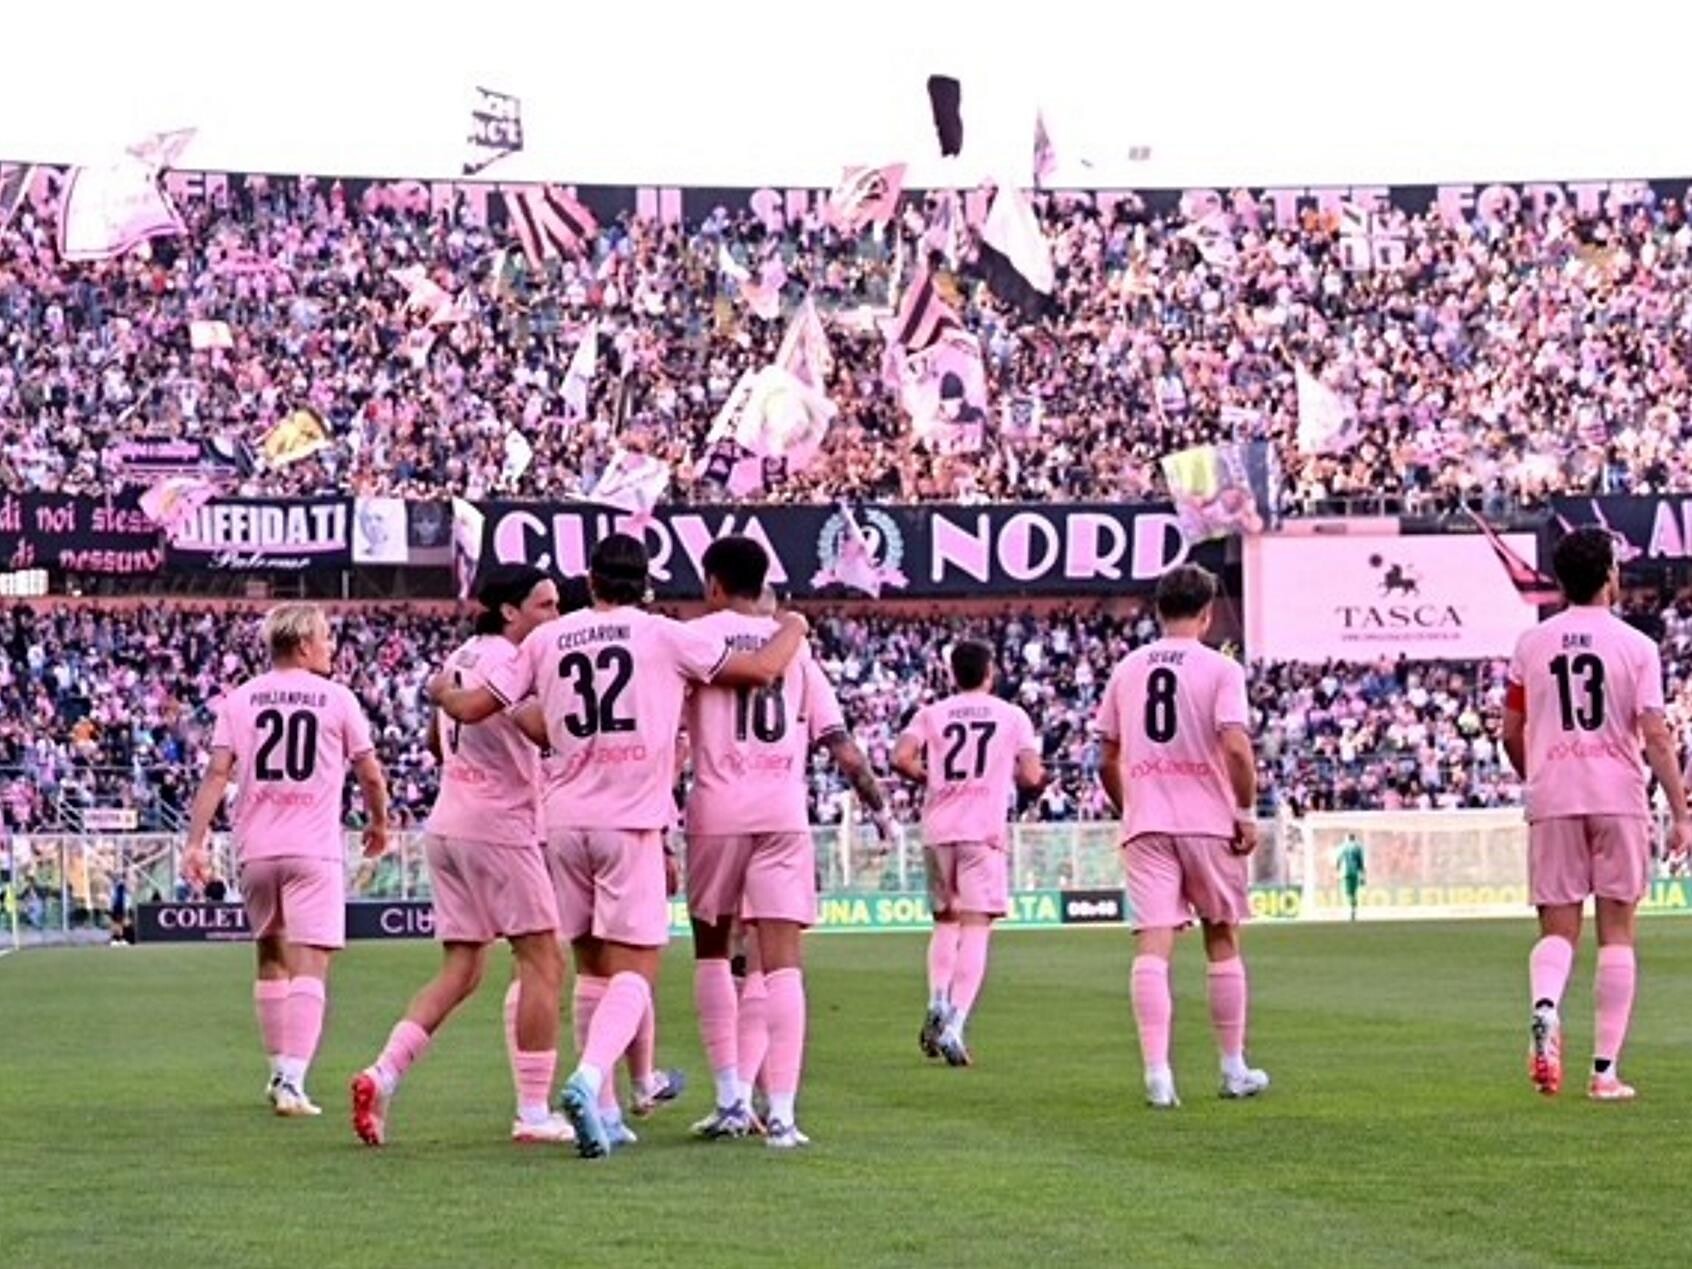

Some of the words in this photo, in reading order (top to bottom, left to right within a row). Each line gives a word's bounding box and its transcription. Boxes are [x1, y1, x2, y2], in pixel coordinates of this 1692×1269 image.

[932, 512, 1191, 583] NORD
[557, 625, 630, 650] CECCARONI
[1334, 604, 1465, 628] TASCA
[558, 645, 637, 738] 32
[1144, 667, 1178, 744] 8
[1548, 653, 1605, 732] 13
[255, 708, 318, 782] 20
[942, 722, 997, 780] 27
